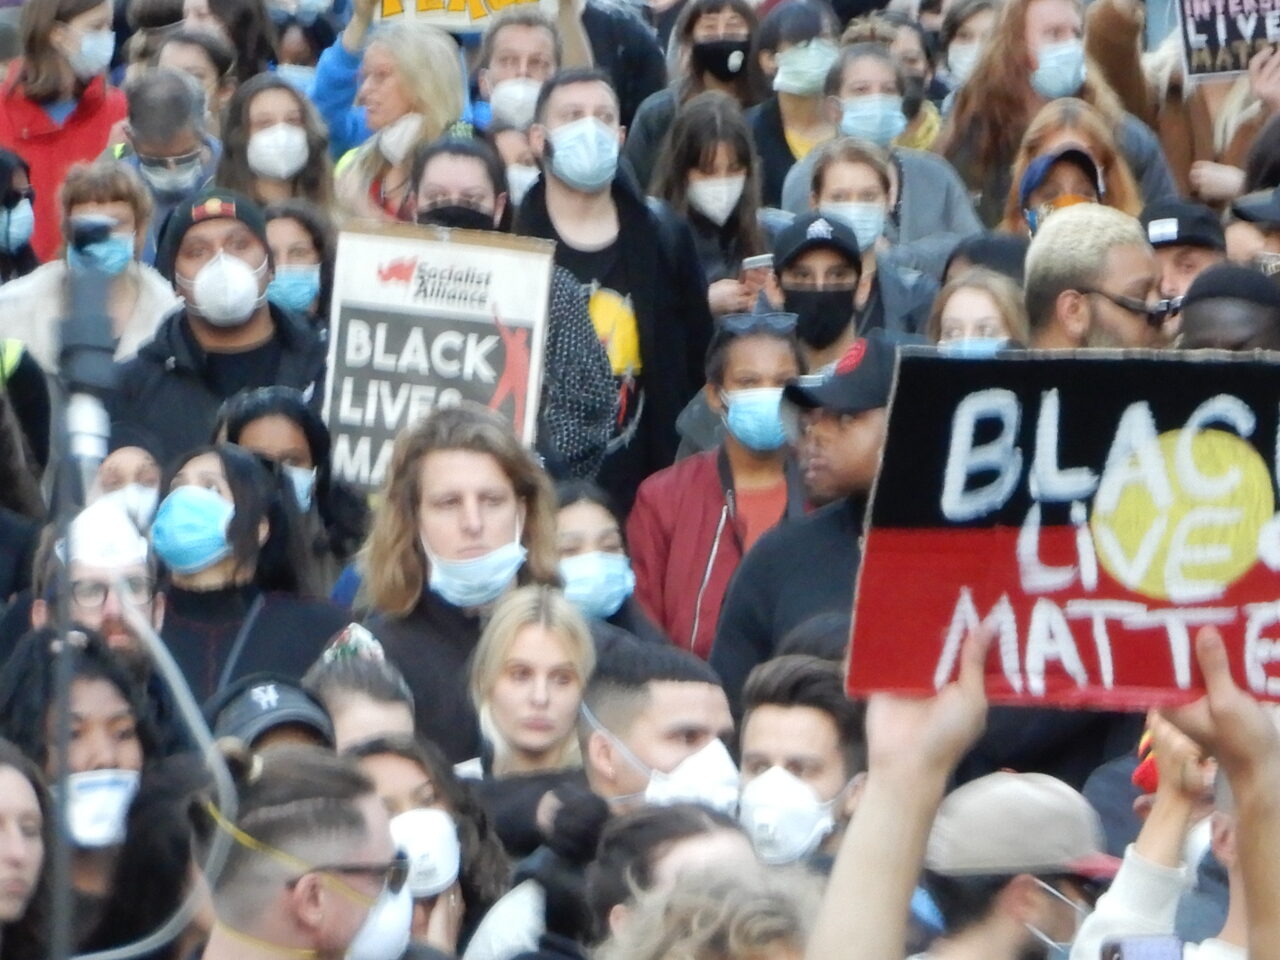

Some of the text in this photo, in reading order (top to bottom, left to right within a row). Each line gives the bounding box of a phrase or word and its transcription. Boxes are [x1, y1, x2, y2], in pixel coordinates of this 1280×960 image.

[415, 261, 493, 287] Socialist
[414, 278, 488, 305] Alliance
[345, 318, 500, 384] BLACK
